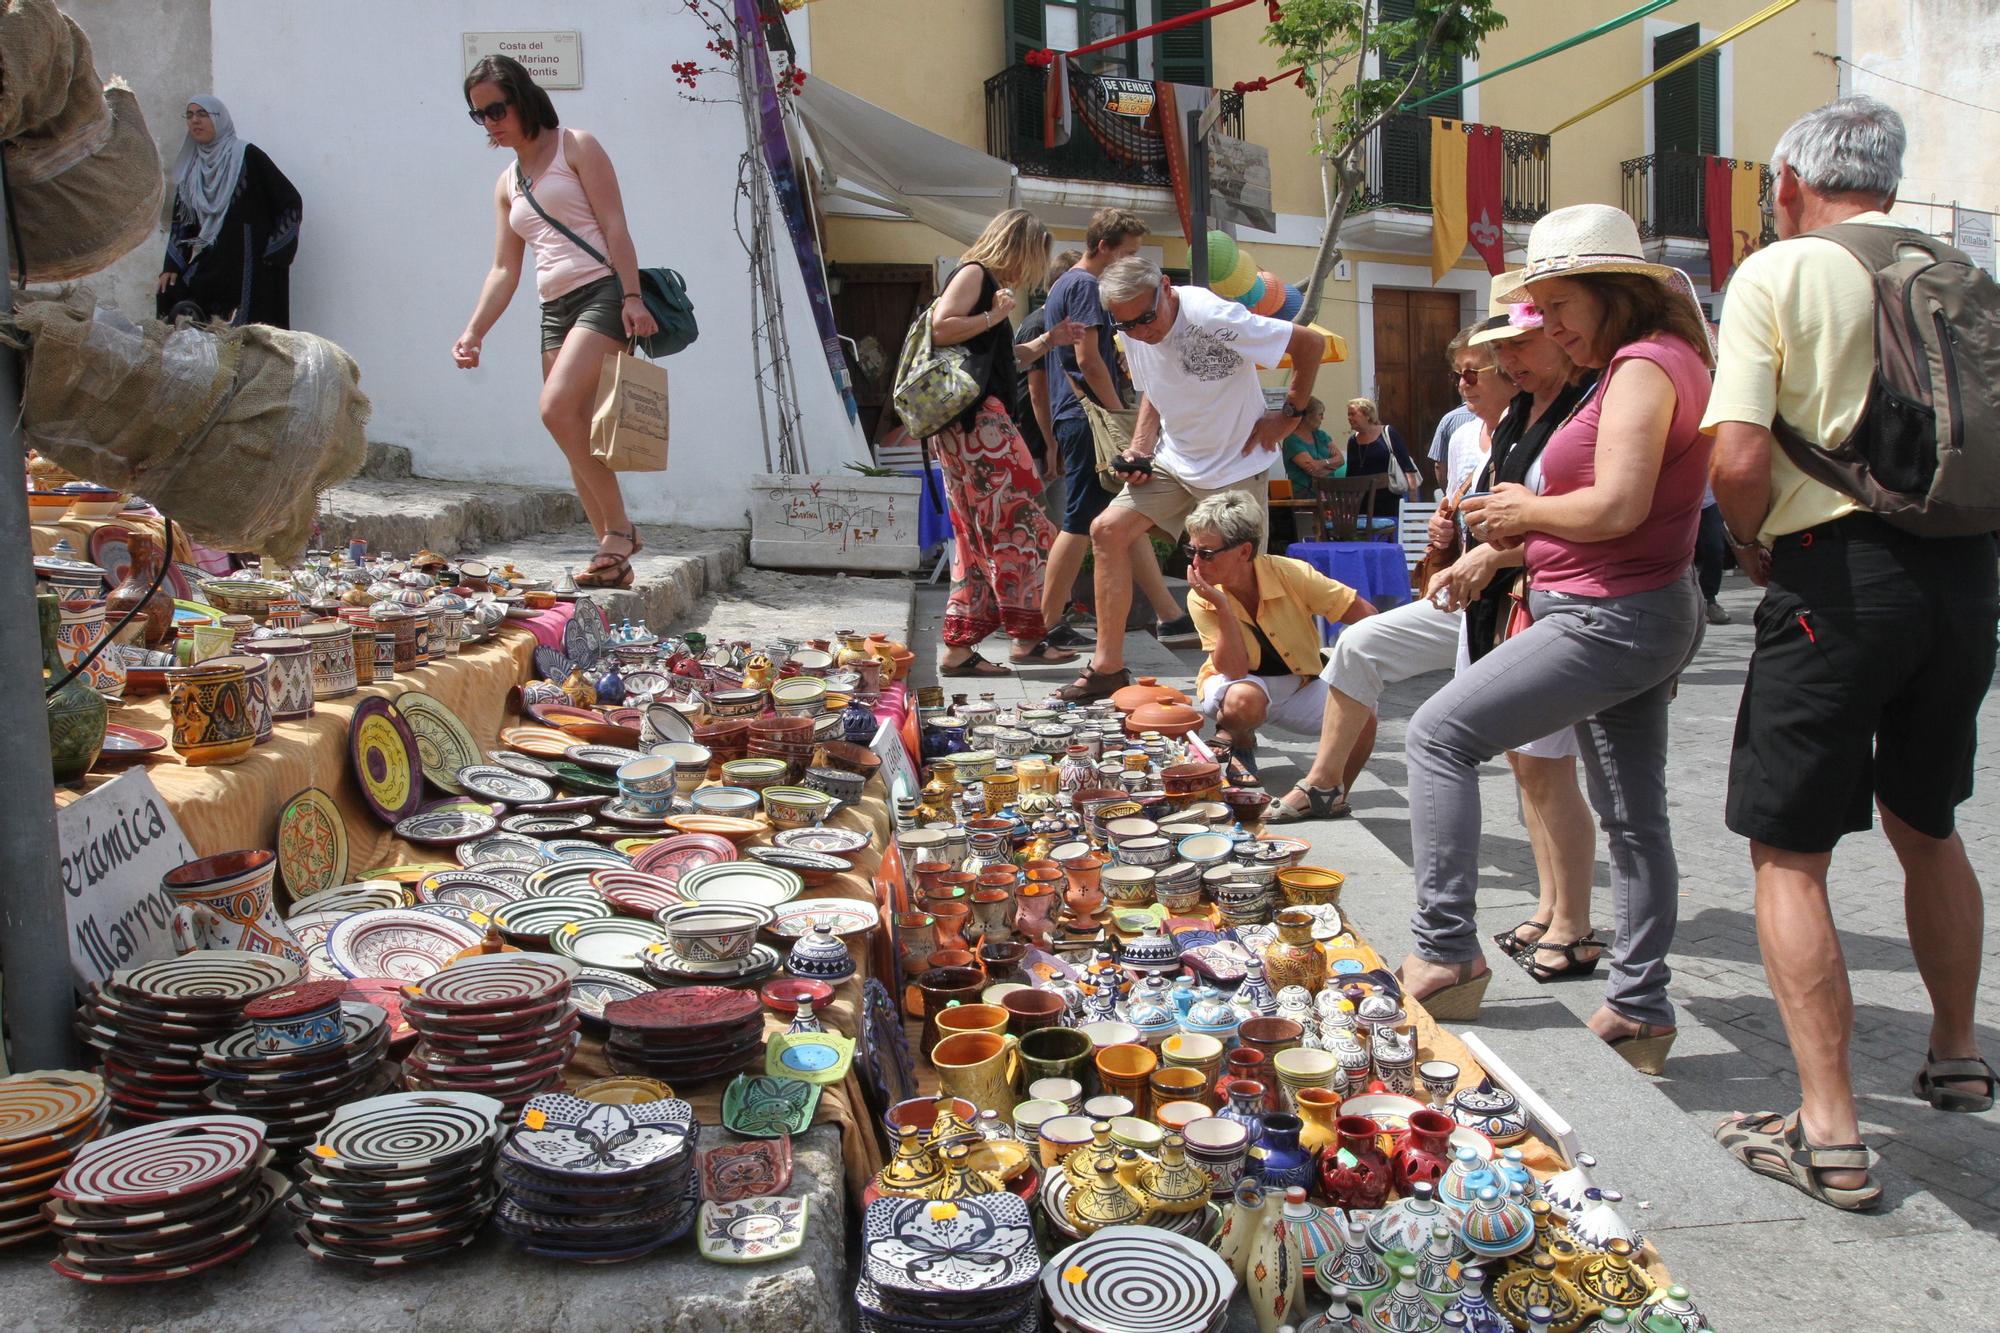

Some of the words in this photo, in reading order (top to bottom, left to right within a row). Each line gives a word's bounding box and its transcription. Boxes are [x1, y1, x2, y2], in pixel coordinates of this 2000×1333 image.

[499, 41, 526, 50] Costa
[529, 41, 543, 50] del
[518, 54, 560, 64] Mariano
[1105, 80, 1119, 90] SE
[1119, 81, 1152, 93] VENDE
[1961, 234, 1988, 247] Villalba
[1340, 263, 1345, 277] 1
[61, 798, 166, 898] erámica
